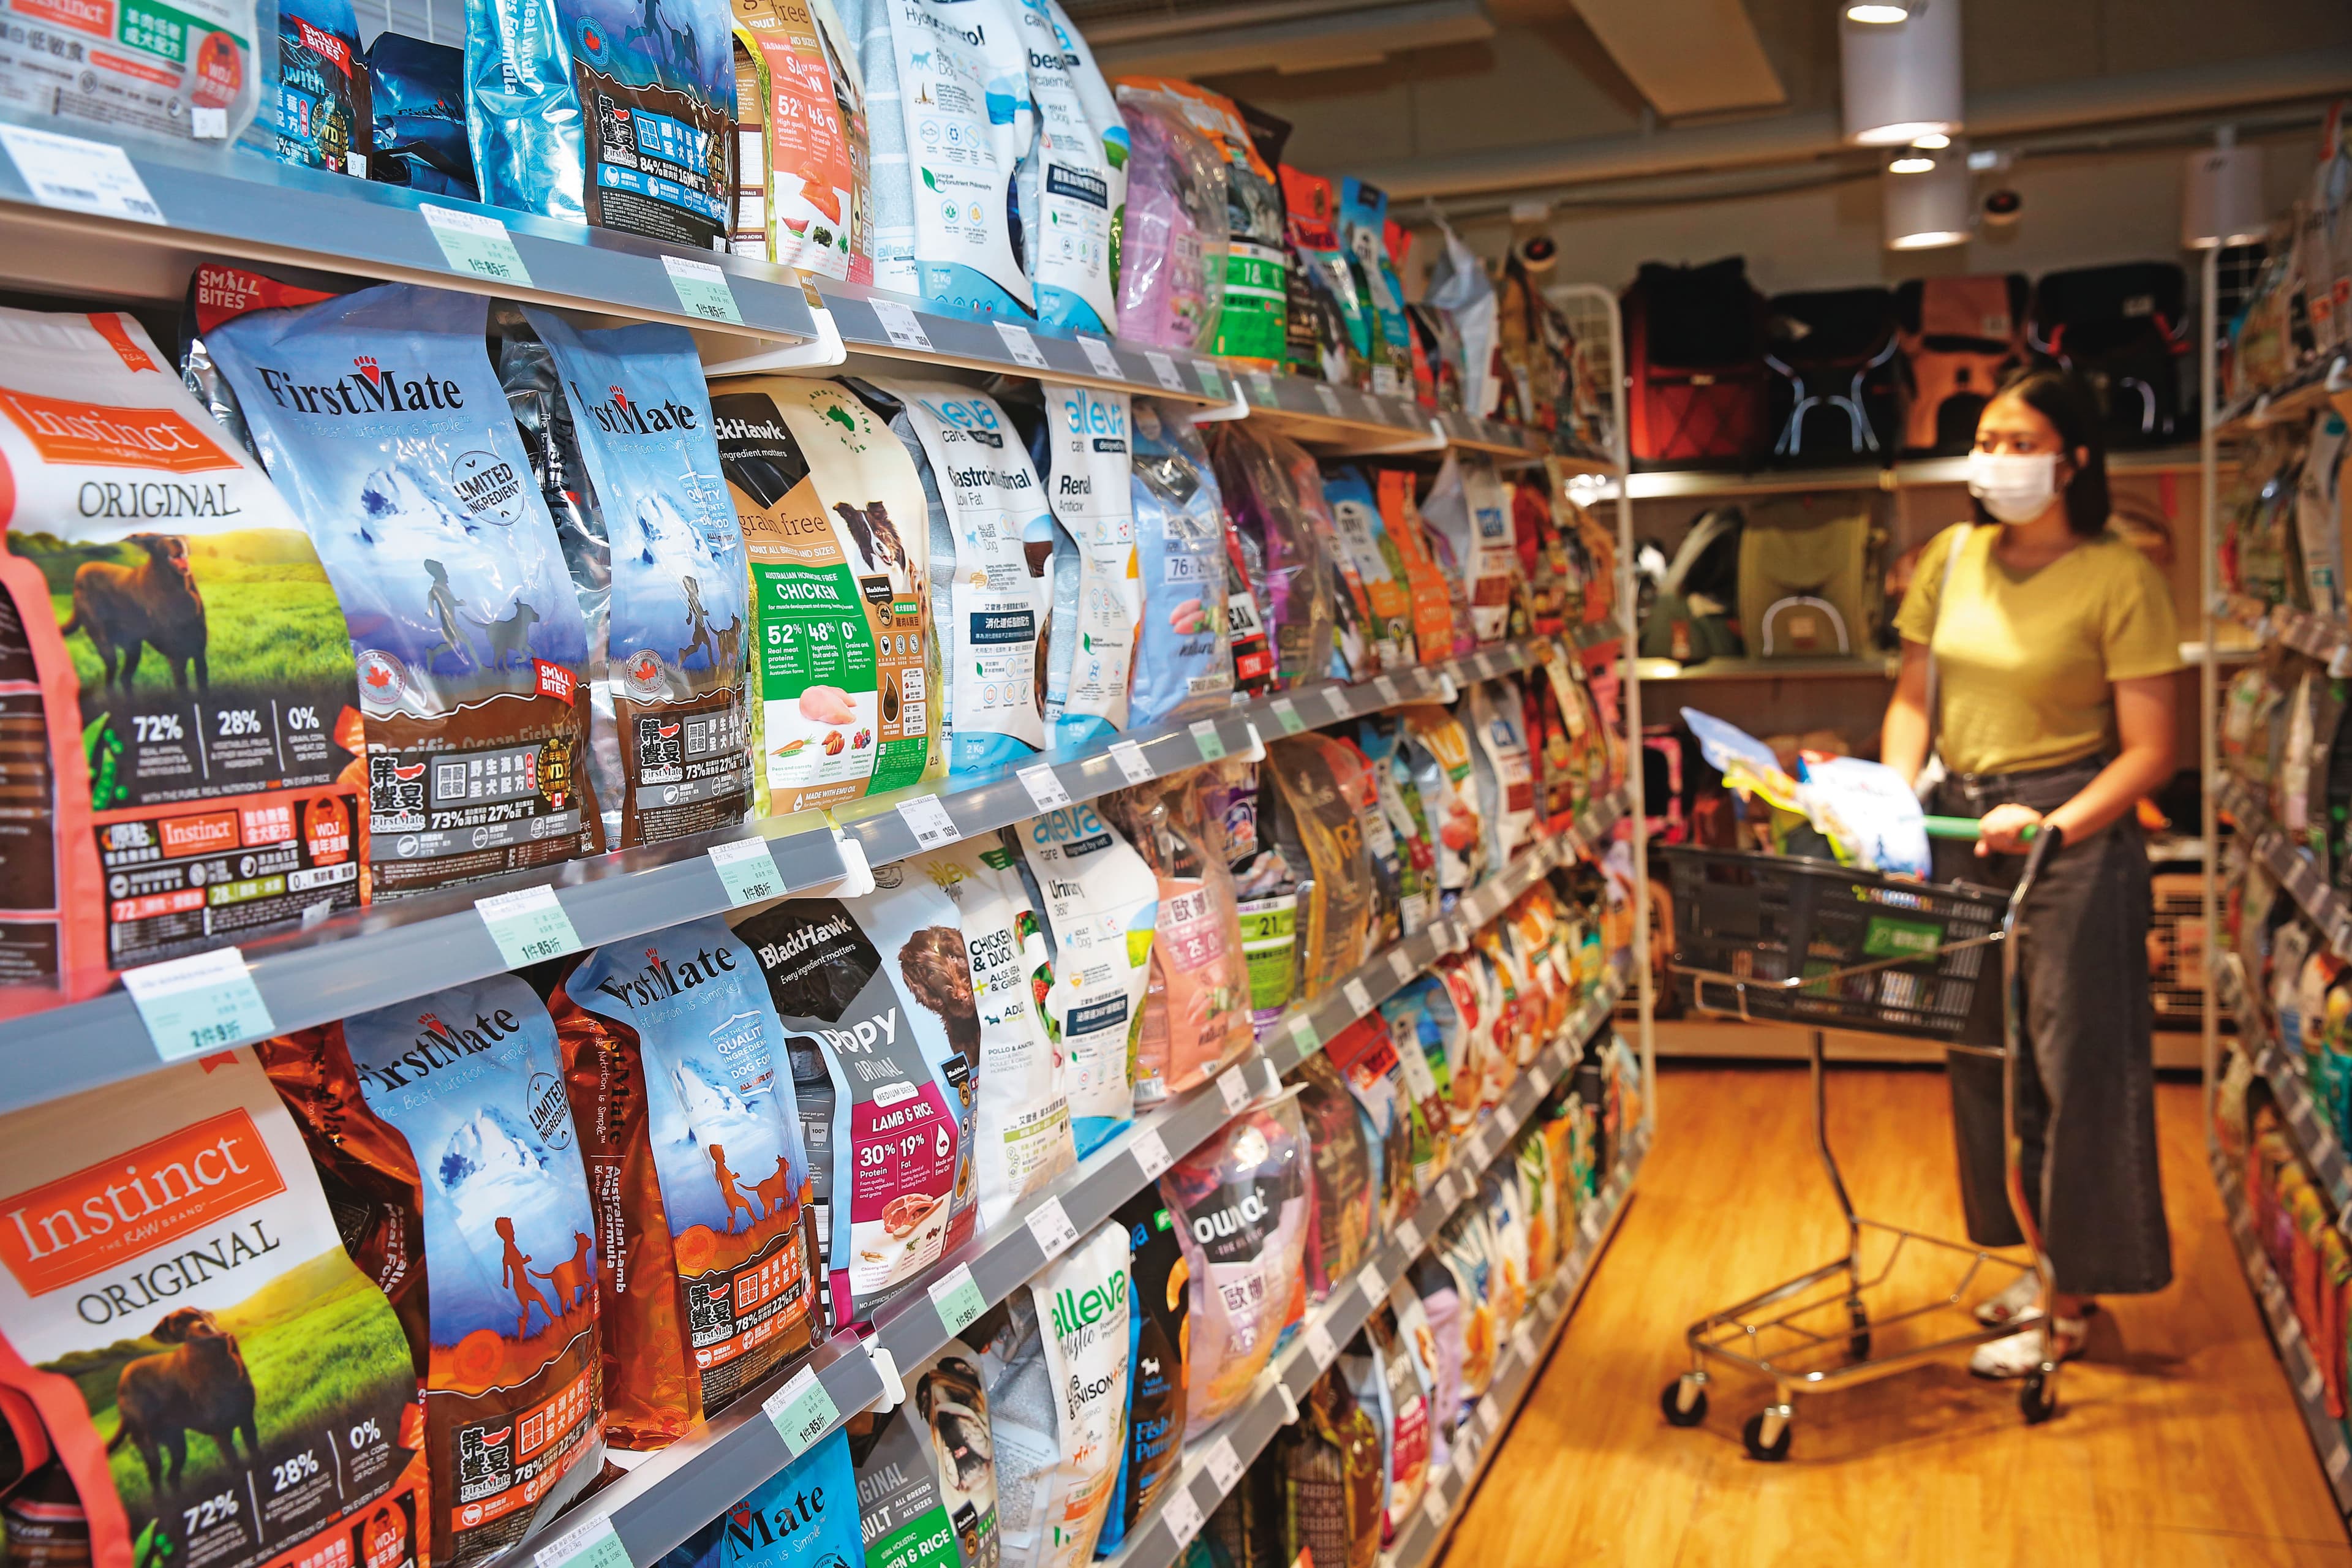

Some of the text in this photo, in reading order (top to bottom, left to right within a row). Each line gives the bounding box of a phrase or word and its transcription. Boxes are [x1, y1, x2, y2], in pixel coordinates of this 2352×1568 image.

[305, 34, 340, 61] BITES
[502, 15, 519, 96] Formula
[521, 37, 537, 78] with
[282, 64, 325, 96] with
[777, 94, 804, 118] 52%
[777, 118, 791, 127] High
[777, 127, 797, 136] protein
[640, 157, 663, 176] 84%
[199, 270, 260, 296] SMALL
[199, 288, 246, 309] BITES
[255, 366, 465, 415] FirstMate
[5, 394, 199, 452] Instinct
[722, 448, 788, 462] ingredient matters
[454, 461, 513, 503] LIMITED
[78, 481, 243, 519] ORIGINAL
[466, 479, 521, 515] INGREDIENT
[968, 493, 984, 506] Fat
[739, 513, 827, 537] grain free
[749, 545, 767, 554] ADULT
[767, 545, 779, 554] ALL
[815, 545, 836, 557] SIZES
[983, 540, 998, 553] Dog
[765, 571, 839, 582] AUSTRALIAN FREE
[775, 582, 839, 601] CHICKEN
[767, 621, 858, 645] 52% 48% 0%
[767, 654, 794, 664] proteins
[811, 644, 838, 653] Vegetables,
[540, 665, 571, 687] SMALL
[541, 677, 567, 696] BITES
[132, 706, 320, 743] 72% 28% 0%
[973, 744, 985, 755] Kg
[469, 755, 525, 778] 野生海魚
[642, 766, 683, 779] FirstMate
[686, 763, 706, 780] 73%
[720, 756, 734, 773] 27%
[469, 774, 526, 799] 全犬配方
[805, 792, 822, 801] MADE
[823, 790, 836, 798] WITH
[835, 787, 848, 796] EMU
[371, 813, 426, 827] FirstMate
[431, 810, 465, 829] 73%
[488, 804, 516, 823] 27%
[165, 820, 232, 845] Instinct
[315, 821, 341, 837] WDJ
[742, 882, 772, 900] 1件85折
[521, 937, 562, 960] 1件85折
[758, 913, 853, 970] BlackHawk
[970, 928, 1013, 957] CHICKEN
[780, 943, 857, 986] Every ingredient matters
[973, 944, 1015, 972] & DUCK
[189, 1021, 243, 1046] 2件9折
[713, 1027, 742, 1044] ONLY THE
[730, 1062, 755, 1079] DOG
[403, 1064, 486, 1111] Best Nutrition
[876, 1089, 900, 1102] MEDIUM
[528, 1079, 564, 1130] LIMITED
[538, 1099, 568, 1144] INGREDIENT
[872, 1102, 935, 1133] LAMB & RICE
[859, 1133, 925, 1167] 30% 19%
[859, 1160, 911, 1180] Protein Fat
[6, 1136, 250, 1262] Instinct
[123, 1219, 159, 1246] RAW
[160, 1203, 203, 1228] BRAND
[601, 1165, 615, 1270] Meal Formula
[610, 1165, 627, 1294] Australian Lamb
[76, 1218, 280, 1325] ORIGINAL
[761, 1245, 796, 1282] 澳洲羊肉
[772, 1292, 790, 1314] 22%
[692, 1324, 733, 1343] FirstMate
[736, 1311, 758, 1334] 78%
[349, 1417, 382, 1450] 0%
[799, 1412, 827, 1443] 1件85折
[558, 1431, 576, 1457] 22%
[272, 1449, 319, 1493] 28%
[515, 1458, 543, 1485] 78%
[461, 1473, 510, 1498] FirstMate
[895, 1483, 932, 1508] ALL BREEDS
[184, 1489, 239, 1536] 72%
[903, 1496, 933, 1519] ALL SIZES
[373, 1528, 398, 1550] WDJ
[907, 1528, 951, 1564] & RICE
